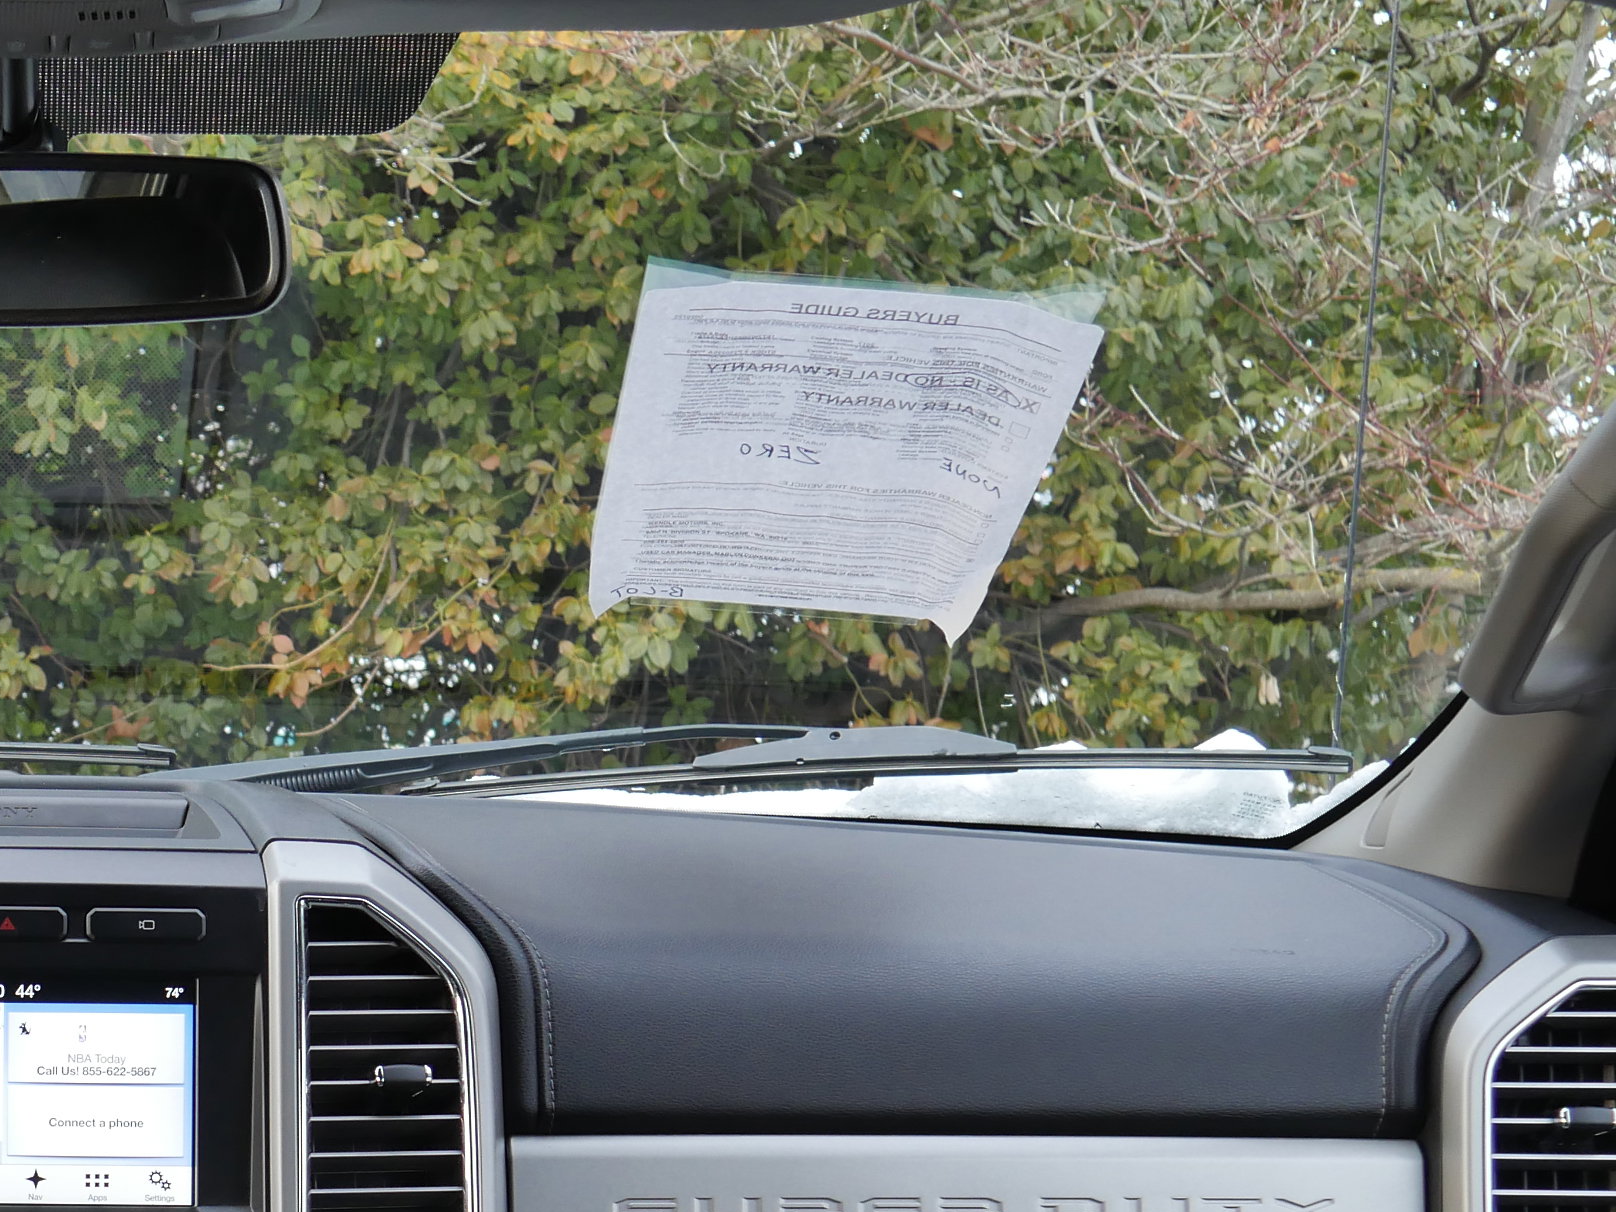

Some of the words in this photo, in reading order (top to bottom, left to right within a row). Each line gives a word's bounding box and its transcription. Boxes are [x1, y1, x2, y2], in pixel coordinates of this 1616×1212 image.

[15, 984, 41, 998] 44°
[164, 986, 184, 999] 74°
[66, 1054, 92, 1065] NBA
[94, 1053, 127, 1067] Today
[36, 1065, 59, 1077] Call
[60, 1066, 80, 1077] Us!
[81, 1066, 157, 1077] 855-622-5867
[48, 1118, 97, 1129] Connect
[99, 1120, 107, 1129] a
[108, 1118, 144, 1131] phone
[27, 1193, 44, 1202] Nav
[87, 1193, 108, 1204] Apps
[144, 1193, 176, 1205] Settings
